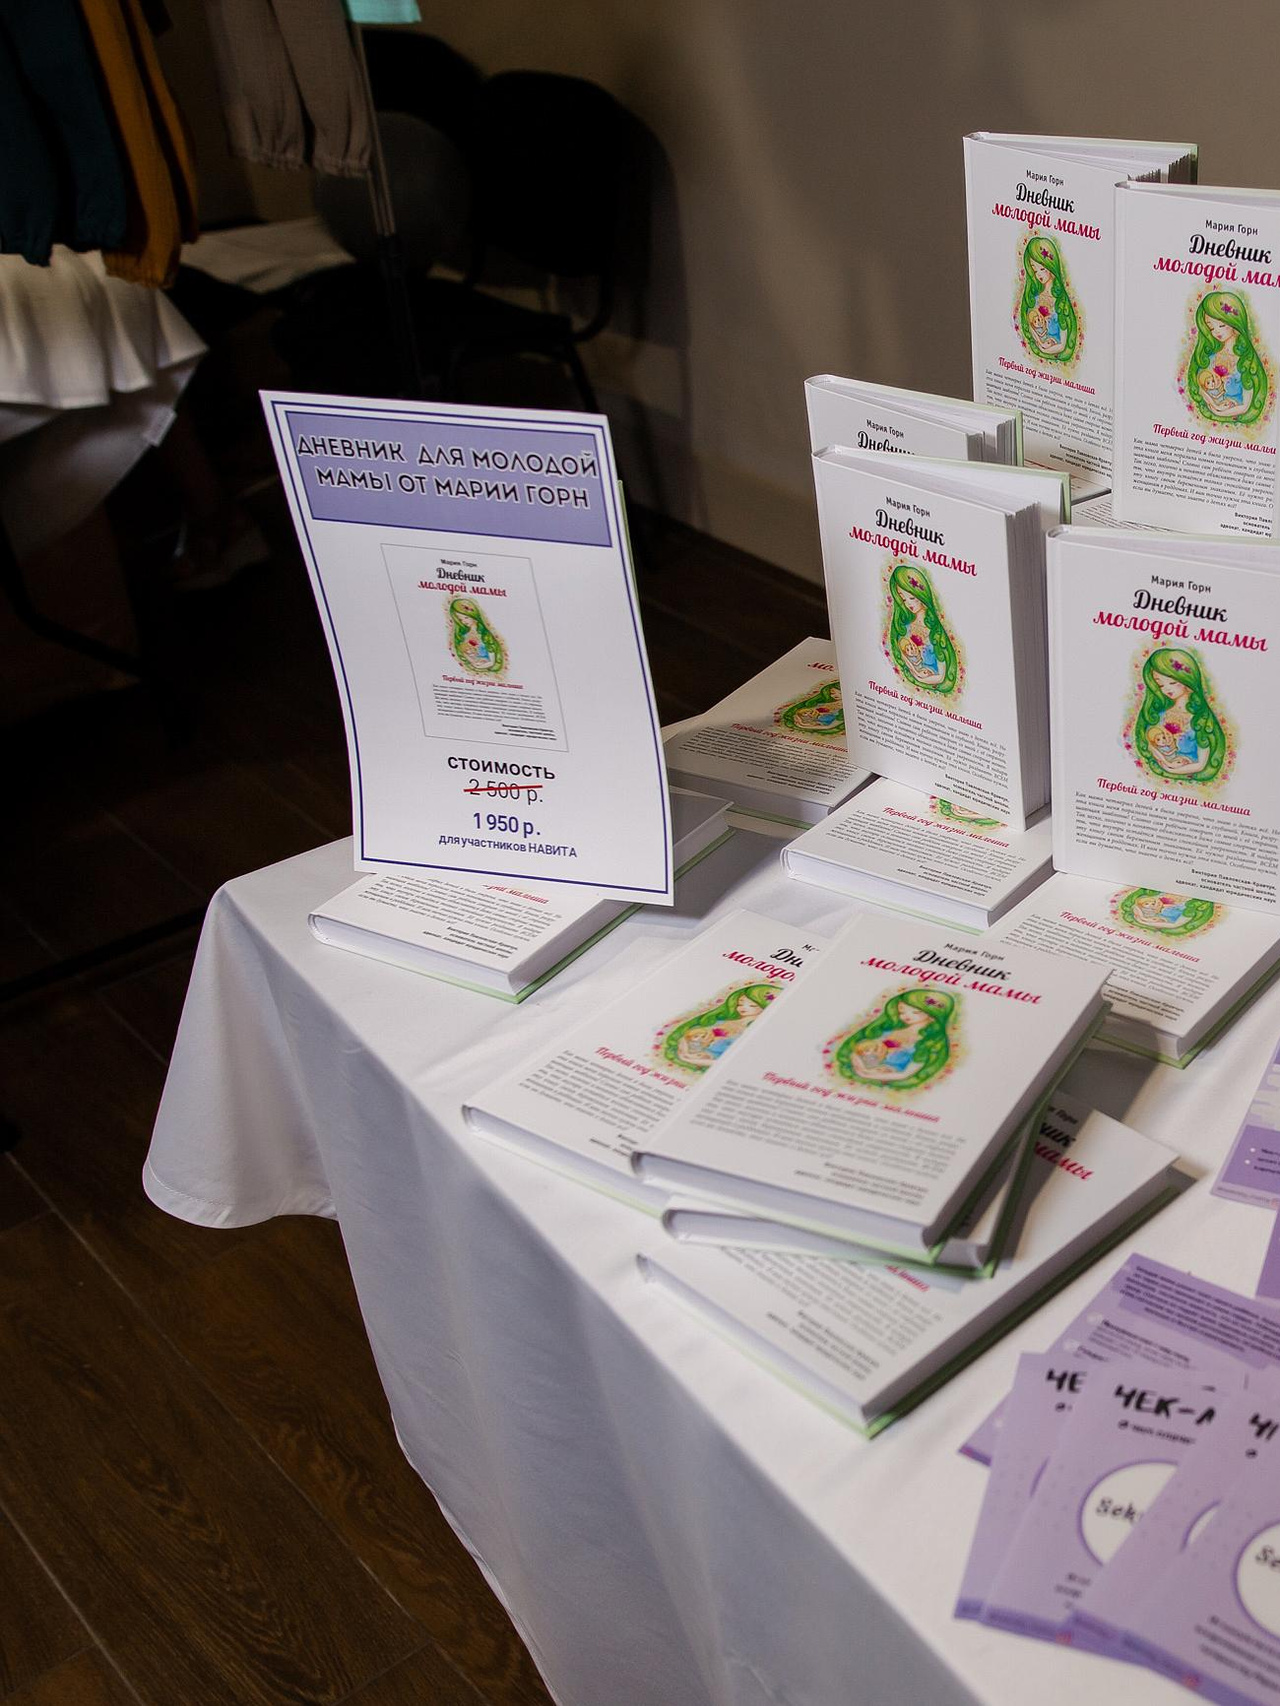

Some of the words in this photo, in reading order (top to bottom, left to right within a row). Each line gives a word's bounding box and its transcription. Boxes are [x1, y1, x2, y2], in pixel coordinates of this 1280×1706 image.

[1026, 170, 1048, 183] Мария
[1049, 174, 1065, 187] Горн
[1016, 183, 1075, 213] Дневник
[992, 203, 1052, 229] молодой
[1054, 218, 1102, 240] мамы
[1205, 219, 1235, 232] Мария
[1238, 224, 1258, 236] Горн
[1189, 234, 1272, 264] Дневник
[1154, 256, 1238, 283] молодой
[999, 357, 1025, 374] Первый
[1025, 367, 1037, 379] год
[866, 419, 888, 434] Мария
[889, 426, 904, 439] Горн
[1153, 423, 1189, 439] Первый
[1190, 432, 1207, 445] год
[1208, 436, 1242, 449] жизни
[298, 436, 405, 462] ДНЕВНИК
[418, 444, 464, 466] ДЛЯ
[472, 448, 598, 477] МОЛОДОЙ
[315, 467, 391, 490] МАМЫ
[398, 474, 426, 494] ОТ
[434, 479, 518, 502] МАРИИ
[527, 485, 590, 508] ГОРН
[886, 496, 911, 512] Мария
[913, 503, 931, 518] Горн
[875, 508, 946, 547] Дневник
[849, 526, 919, 558] молодой
[922, 551, 978, 577] мамы
[417, 580, 467, 596] молодой
[468, 586, 507, 597] мамы
[436, 567, 486, 583] Дневник
[1151, 575, 1185, 589] Мария
[1188, 580, 1212, 594] Горн
[1132, 589, 1228, 623] Дневник
[1093, 610, 1190, 640] молодой
[1193, 628, 1269, 652] мамы
[868, 680, 900, 700] Первый
[900, 693, 914, 708] год
[914, 699, 944, 716] жизни
[945, 711, 983, 730] малыша
[468, 778, 481, 796] 2
[487, 780, 520, 800] 500
[1097, 777, 1138, 796] Первый
[1140, 786, 1158, 801] год
[1160, 792, 1198, 807] жизни
[1200, 801, 1251, 817] малыша
[473, 812, 482, 829] 1
[486, 814, 519, 833] 950
[523, 821, 542, 839] р.
[438, 835, 463, 846] для
[462, 837, 527, 853] участников
[528, 842, 578, 858] НАВИТА
[722, 951, 796, 981] молодо
[912, 950, 1011, 981] Дневник
[860, 956, 961, 986] молодой
[963, 979, 1043, 1006] мамы
[1114, 1384, 1216, 1426] ЧЕК-Л
